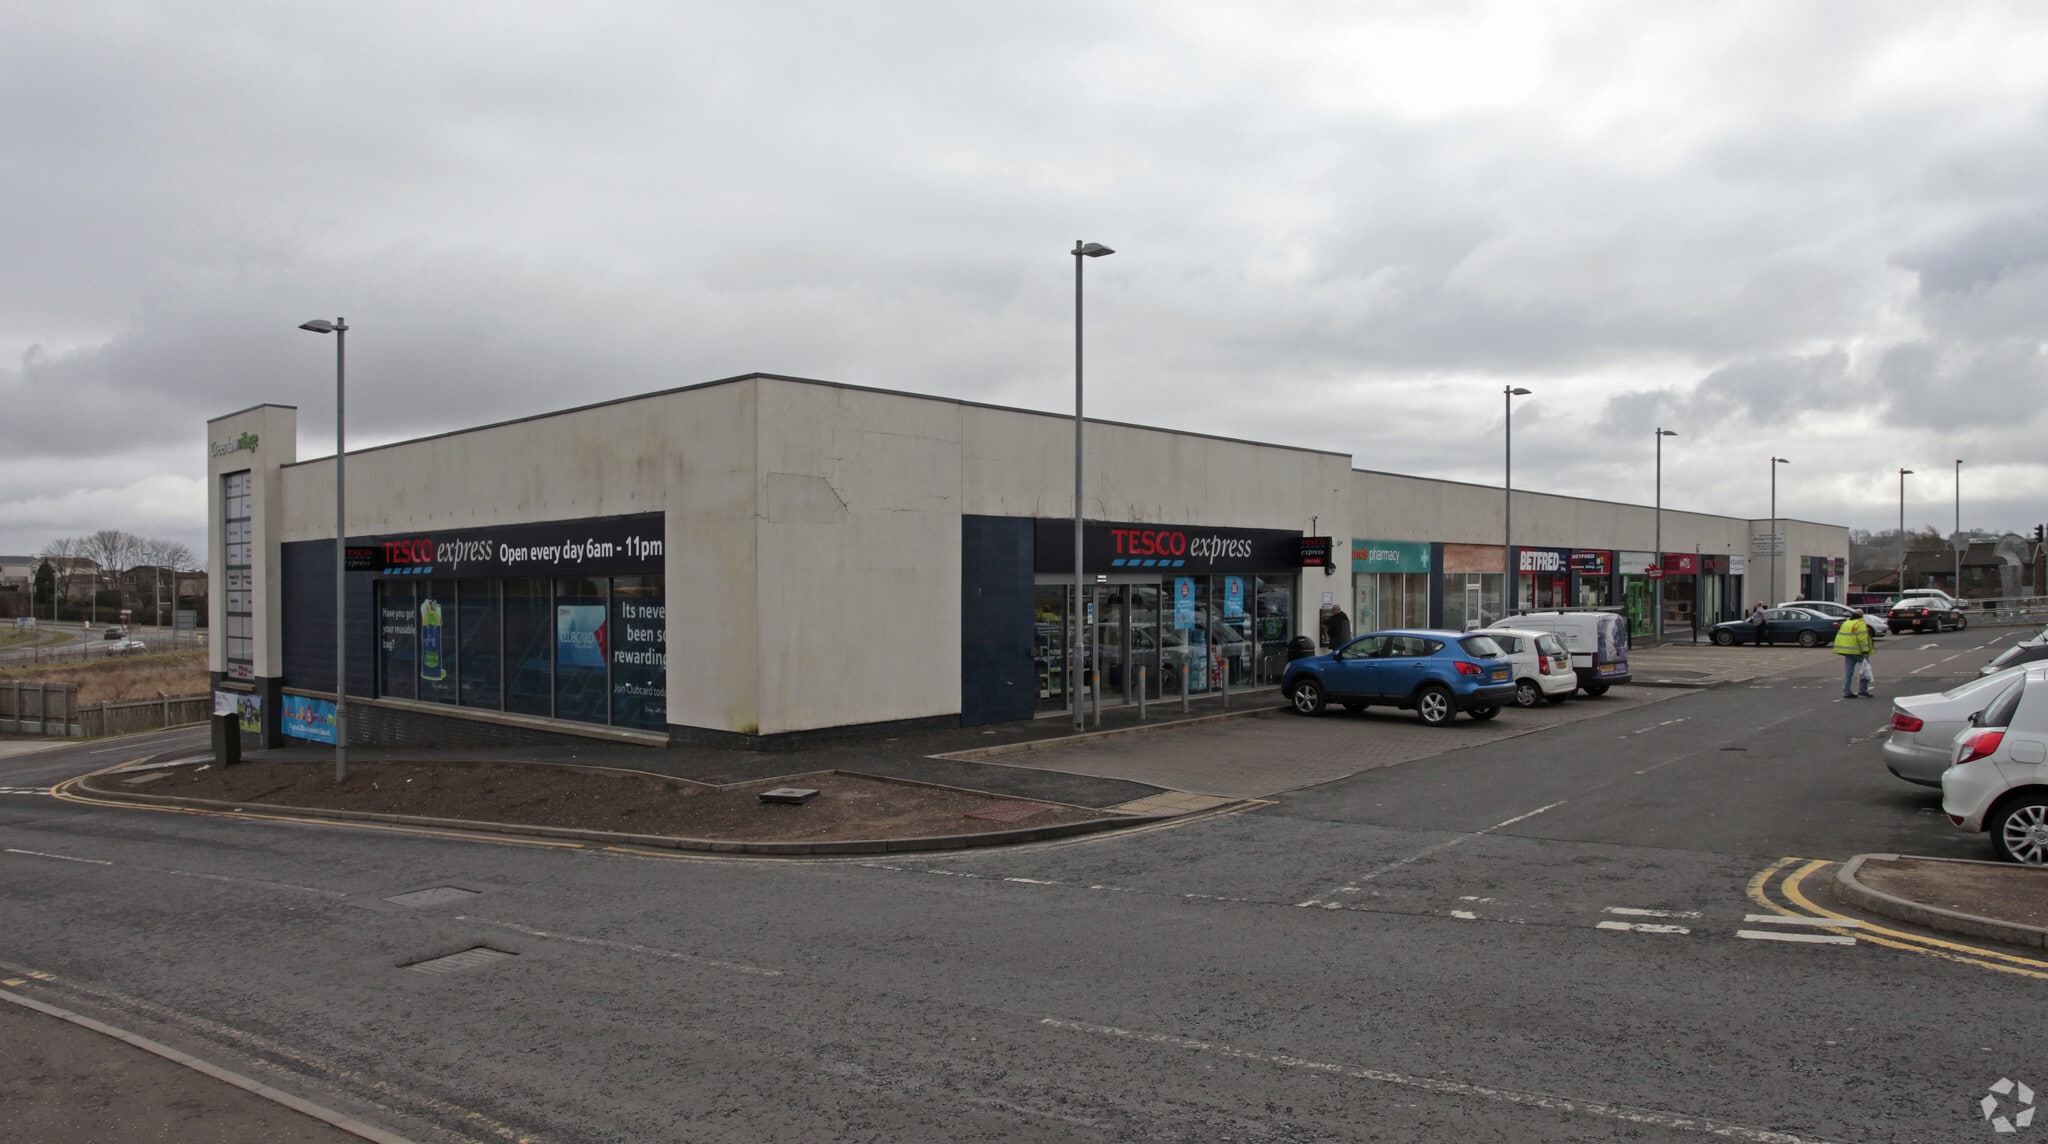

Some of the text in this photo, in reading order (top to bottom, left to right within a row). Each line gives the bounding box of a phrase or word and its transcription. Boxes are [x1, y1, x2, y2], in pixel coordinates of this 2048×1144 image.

[344, 549, 372, 557] ESCO
[383, 538, 492, 570] TESCO express
[500, 543, 527, 566] Open
[530, 546, 560, 564] every
[563, 539, 584, 563] day
[586, 538, 613, 558] 6am
[625, 536, 662, 561] 11pm
[1111, 529, 1251, 565] TESCO express
[1369, 542, 1400, 564] pharmacy
[1520, 551, 1559, 571] BETFRED
[382, 608, 415, 620] Have you got
[622, 602, 666, 619] Its neve
[382, 623, 416, 635] your reusable
[560, 631, 594, 644] CLUBCARD
[627, 624, 653, 641] been
[382, 639, 395, 651] bag?
[614, 647, 667, 666] rewardin
[613, 683, 625, 693] Join
